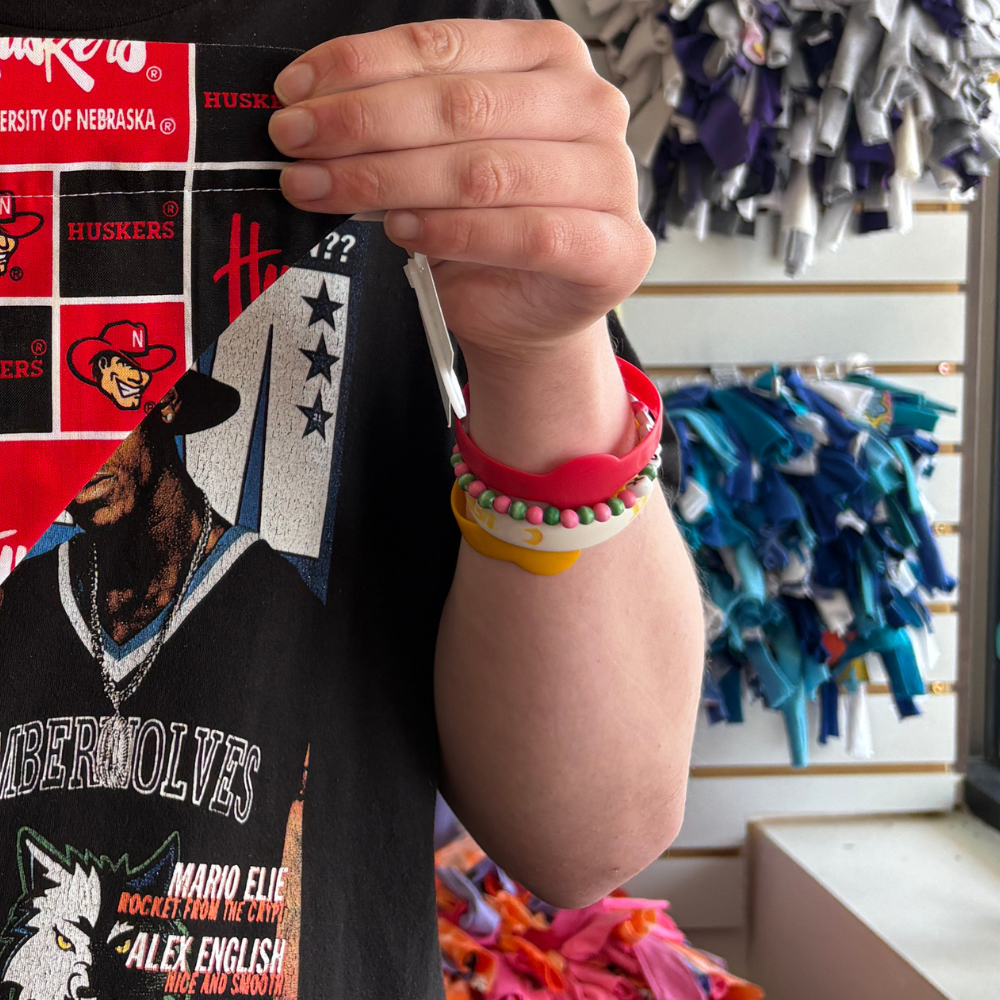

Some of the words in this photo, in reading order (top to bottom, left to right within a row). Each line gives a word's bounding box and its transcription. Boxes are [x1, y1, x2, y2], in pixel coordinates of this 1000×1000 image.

[52, 108, 71, 131] OF
[77, 108, 156, 130] NEBRASKA
[67, 220, 175, 241] HUSKERS
[167, 862, 241, 900] MARIO
[244, 866, 289, 902] ELIE
[117, 891, 181, 919] ROCKET
[182, 897, 221, 921] FROM
[223, 899, 244, 922] THE
[125, 932, 194, 972] ALEX
[194, 936, 288, 975] ENGLISH
[163, 971, 199, 994] NICE
[200, 972, 228, 995] AND
[230, 973, 285, 996] SMOOTH
